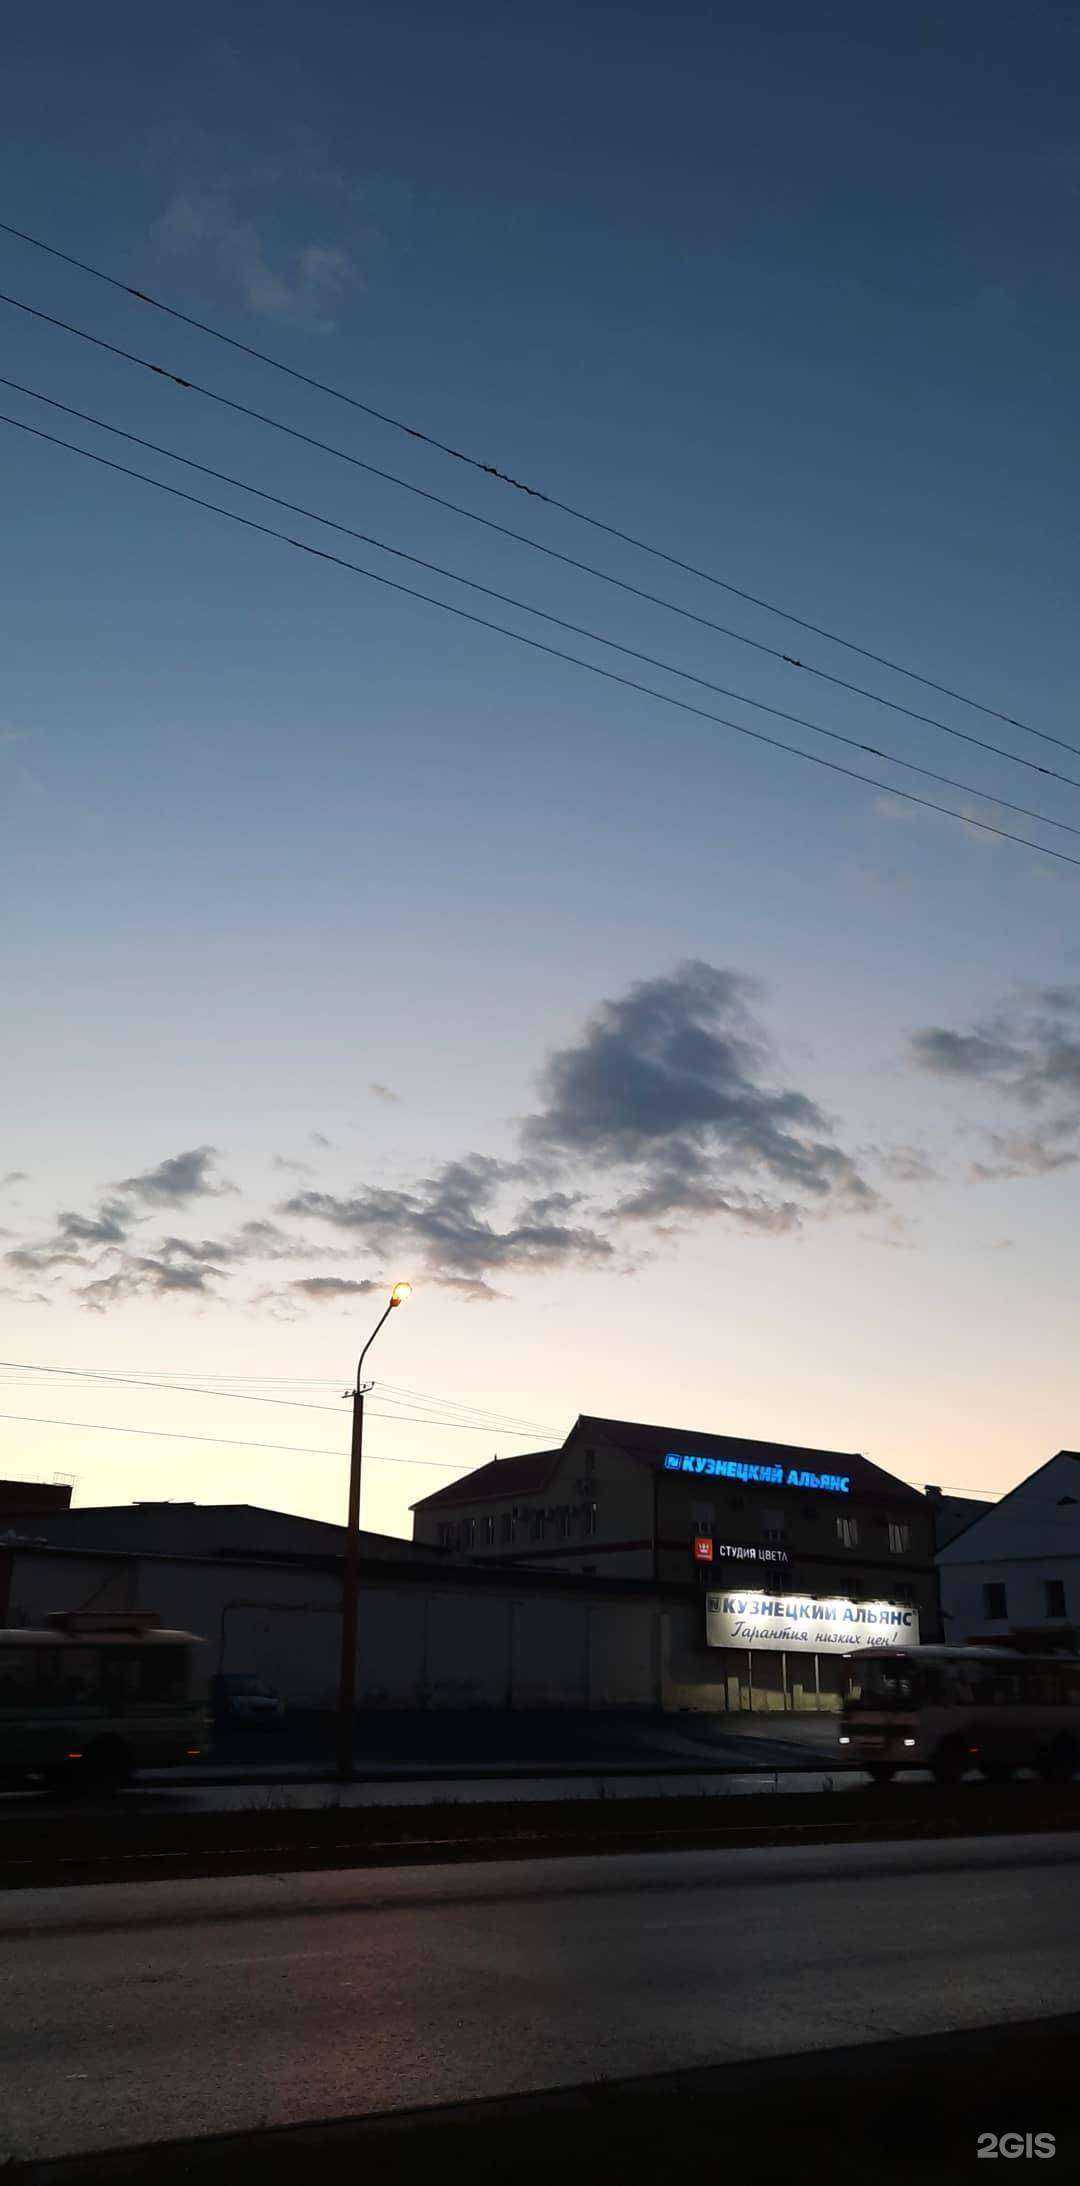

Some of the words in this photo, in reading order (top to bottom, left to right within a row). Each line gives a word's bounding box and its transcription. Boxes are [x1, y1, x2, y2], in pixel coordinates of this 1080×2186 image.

[682, 1456, 783, 1483] КУЗНЕЦКИЙ
[787, 1470, 850, 1493] АЛЬЯНС
[719, 1545, 756, 1560] СТУДИЯ
[842, 1608, 913, 1626] АЛЬЯНС
[731, 1621, 808, 1642] Гарантия
[815, 1632, 861, 1645] низких
[867, 1632, 898, 1646] цен!
